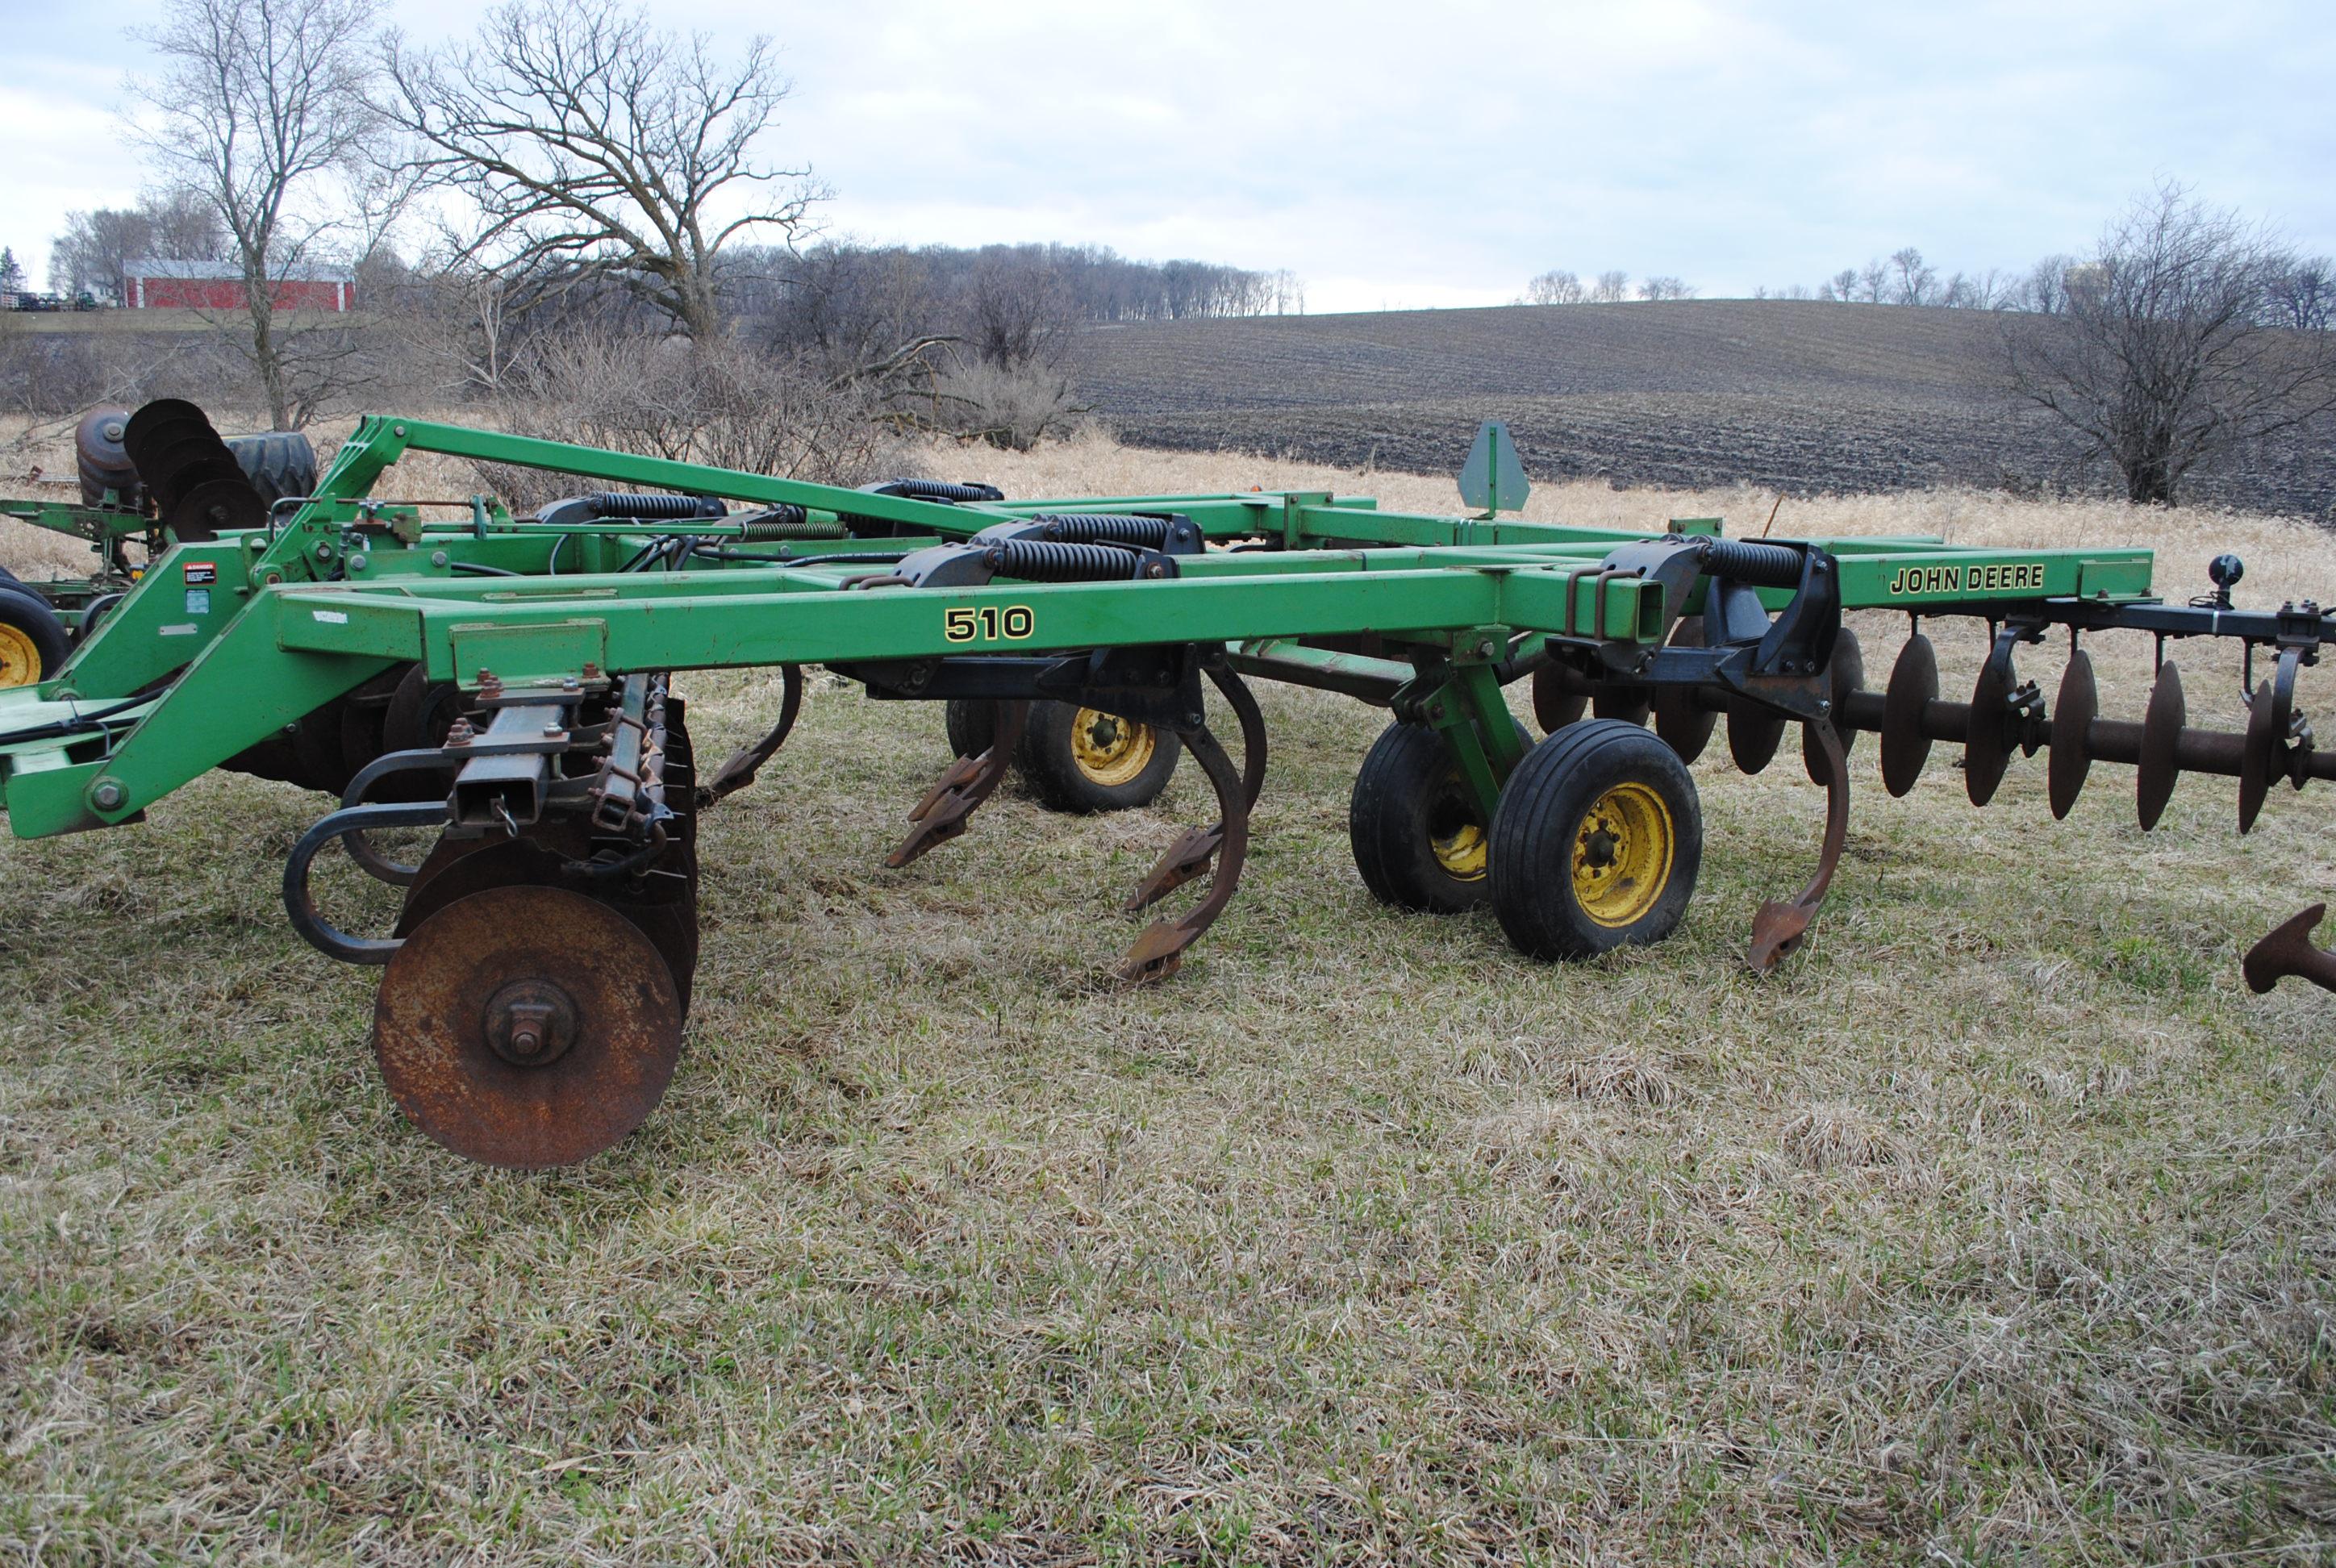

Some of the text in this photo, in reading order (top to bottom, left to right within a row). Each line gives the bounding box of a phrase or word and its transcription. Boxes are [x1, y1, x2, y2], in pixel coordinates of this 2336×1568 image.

[1890, 565, 2044, 594] JOHN DEERE
[945, 606, 1034, 642] 510
